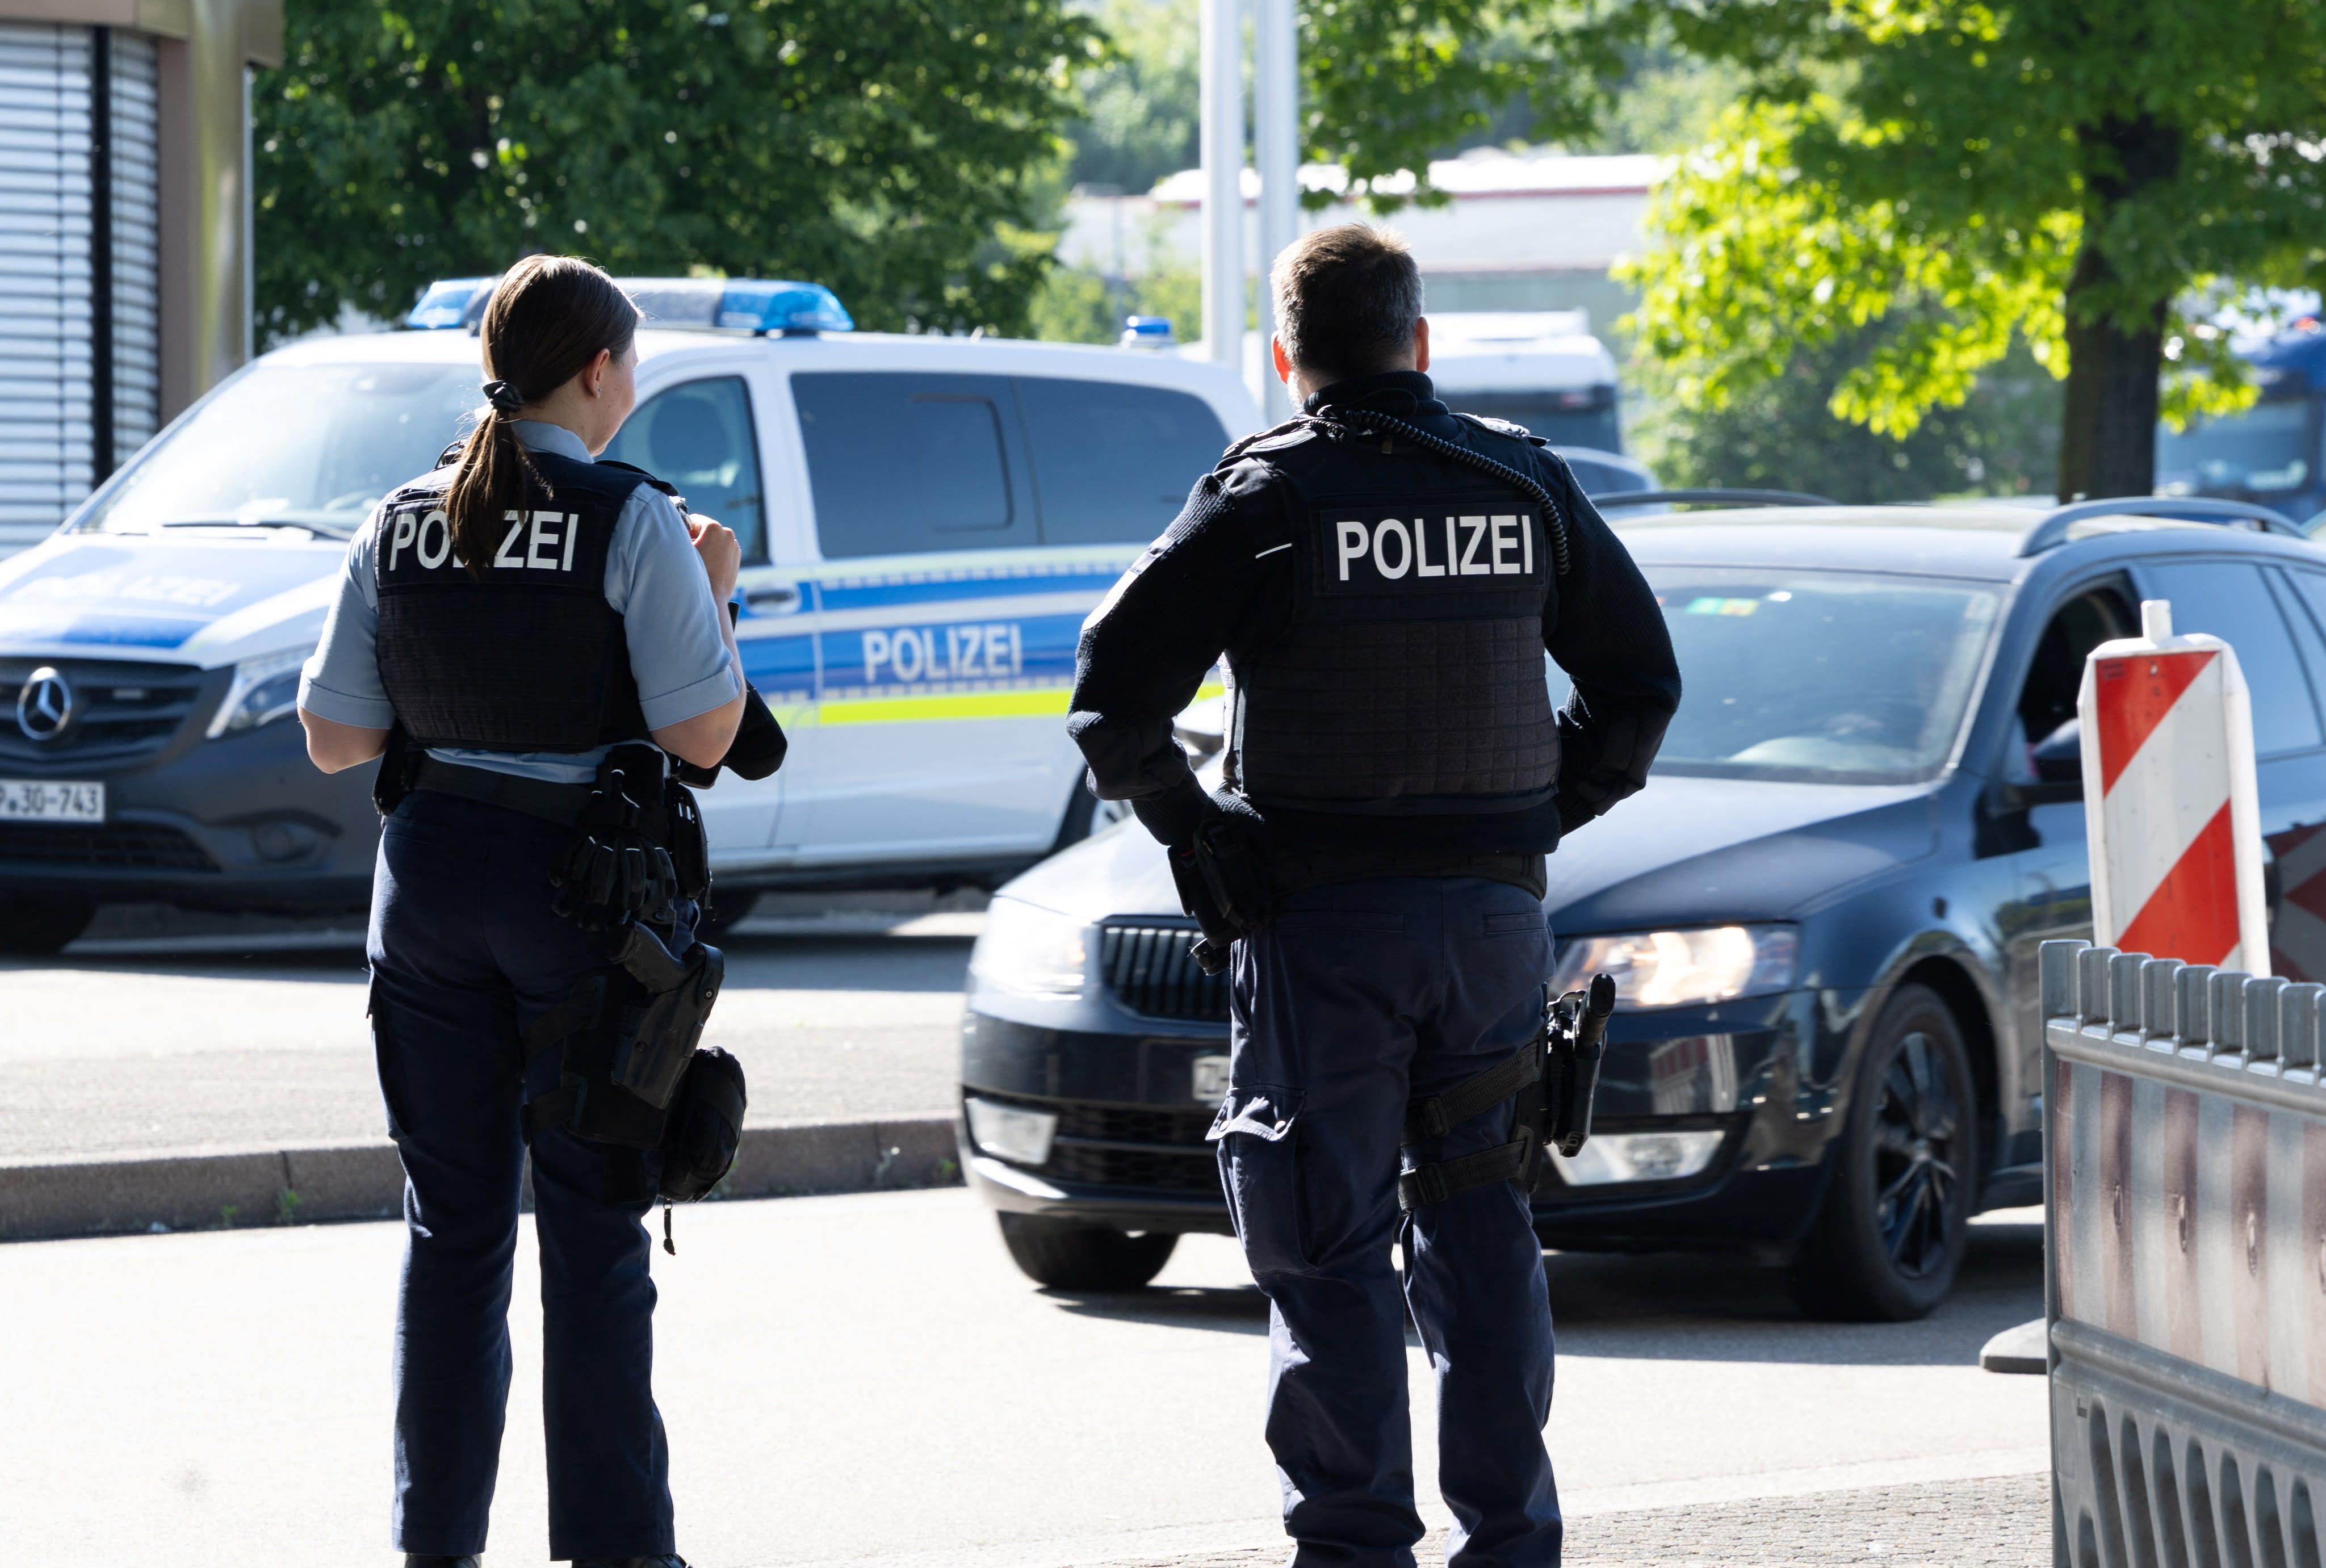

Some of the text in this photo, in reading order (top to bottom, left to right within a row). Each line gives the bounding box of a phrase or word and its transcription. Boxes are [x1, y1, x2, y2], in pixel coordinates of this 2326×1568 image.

[389, 509, 579, 572] POZEI
[1336, 514, 1533, 581] POLIZEI
[862, 623, 1022, 683] POLIZEI
[22, 786, 98, 815] 30-743
